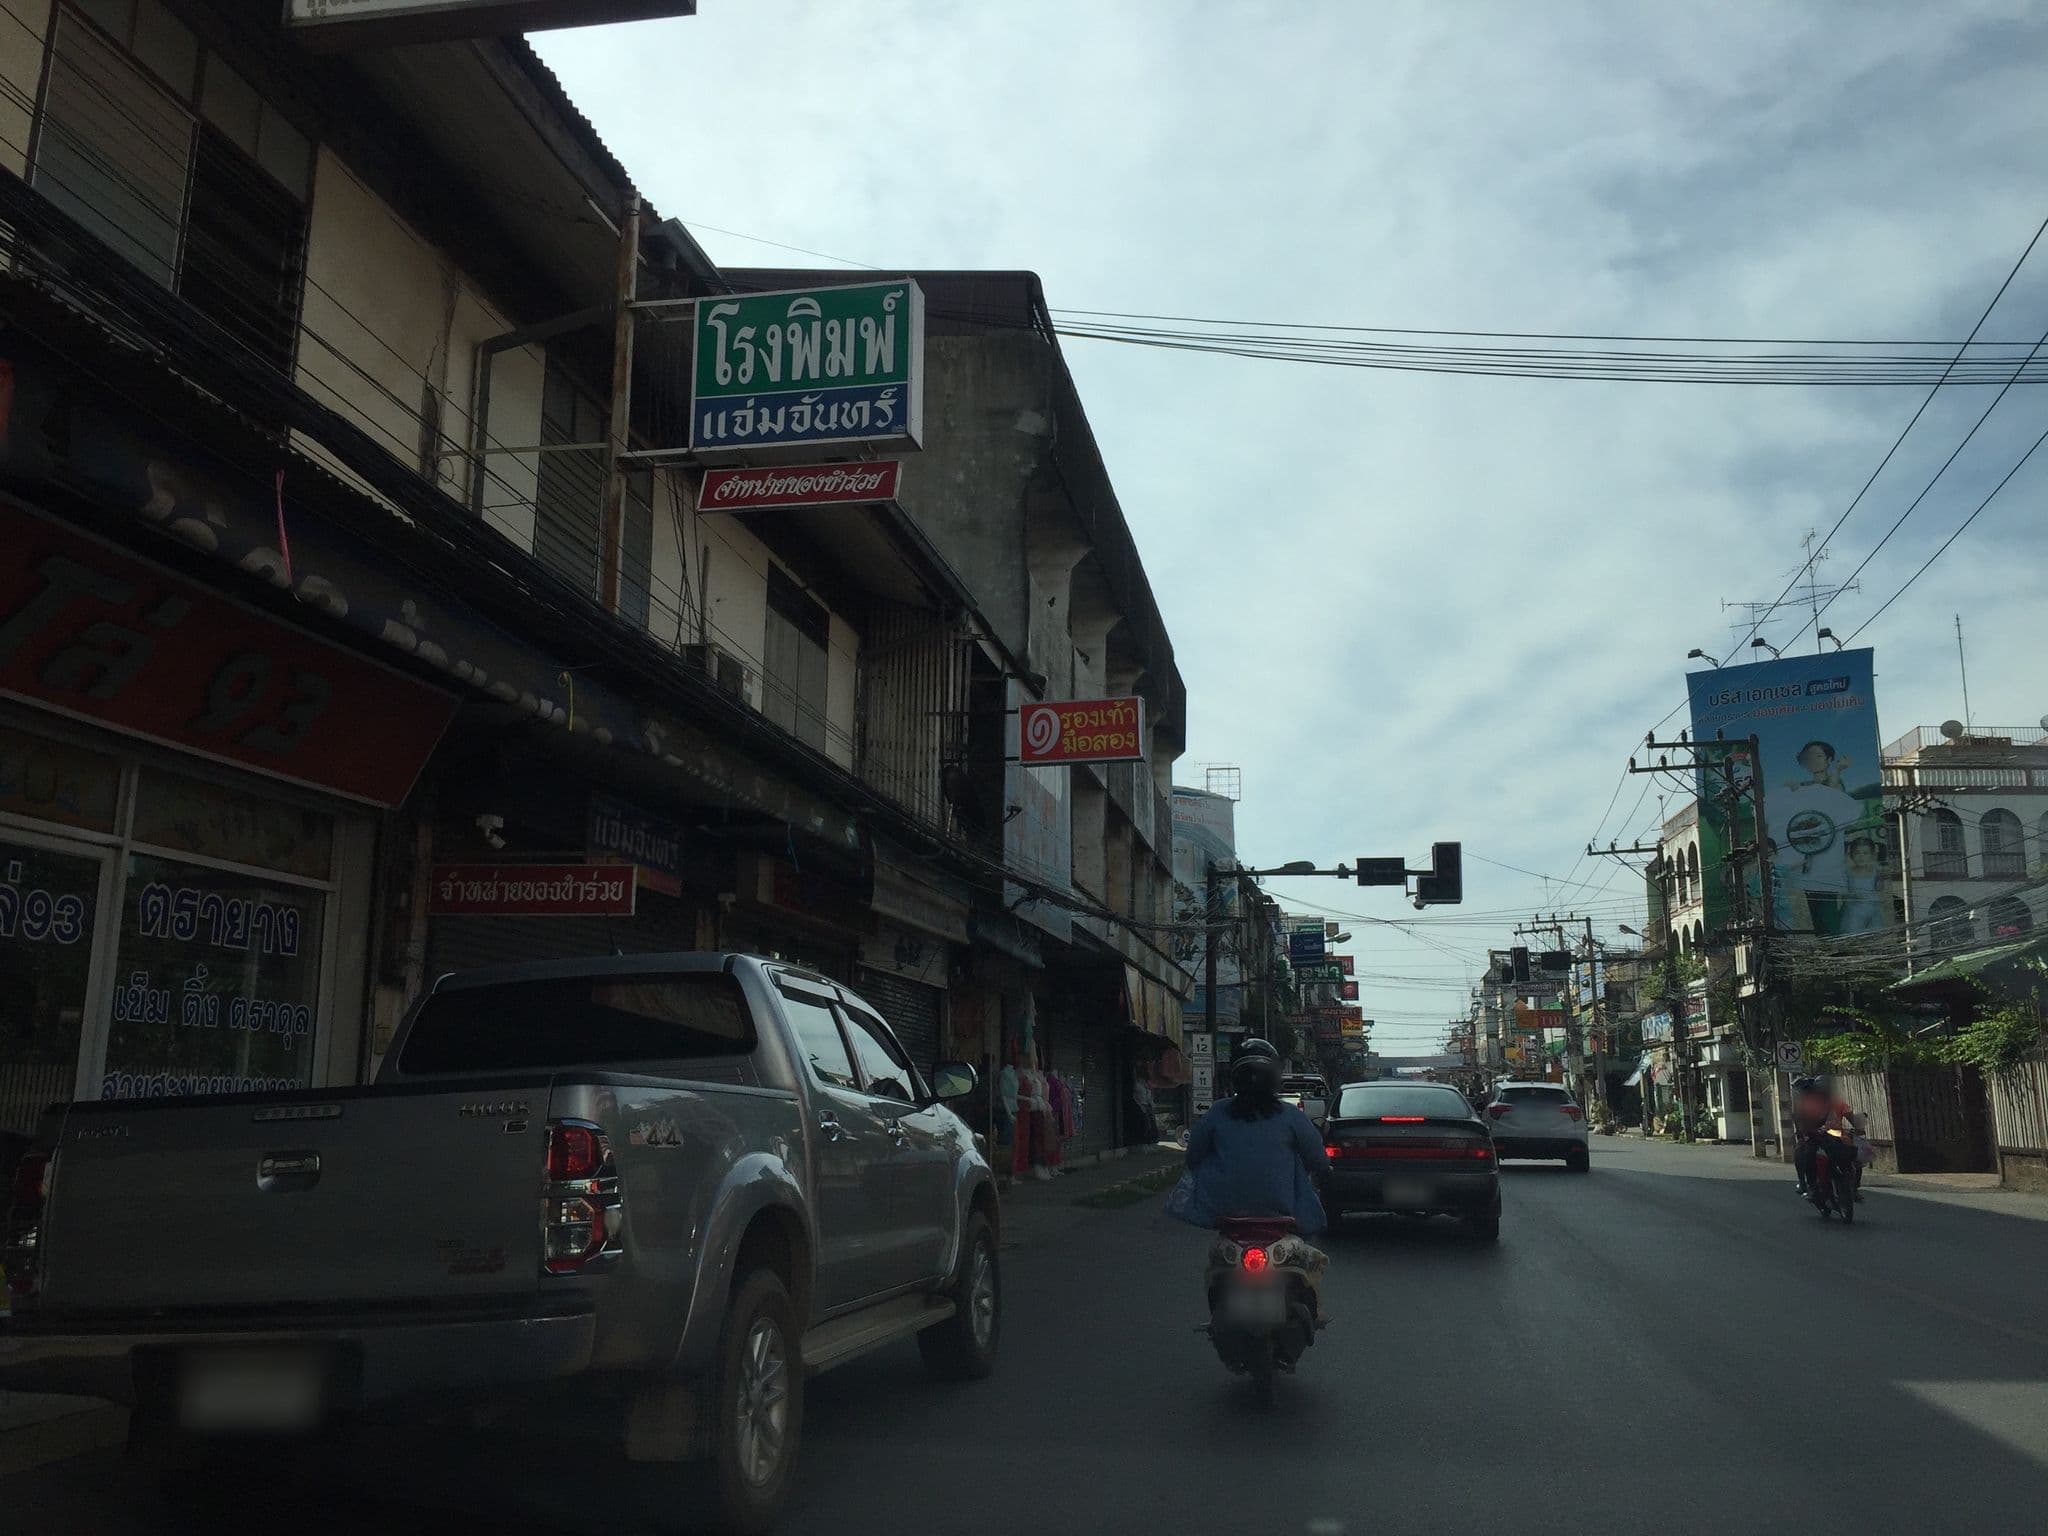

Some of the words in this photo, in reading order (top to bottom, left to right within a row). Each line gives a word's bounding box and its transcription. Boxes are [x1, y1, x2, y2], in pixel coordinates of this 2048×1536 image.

[707, 290, 904, 385] โรงพิมพ์
[703, 387, 898, 439] แจ่มจันทร์
[714, 467, 888, 500] จำหน่ายของชำร่วย
[1061, 700, 1136, 729] รองเท้า
[1062, 729, 1136, 753] มือสอง
[439, 871, 625, 903] จำหน่ายของชำร่วย
[139, 882, 300, 956] ตรายาง
[112, 971, 170, 1023] เข็ม
[229, 995, 311, 1050] ตราดุล
